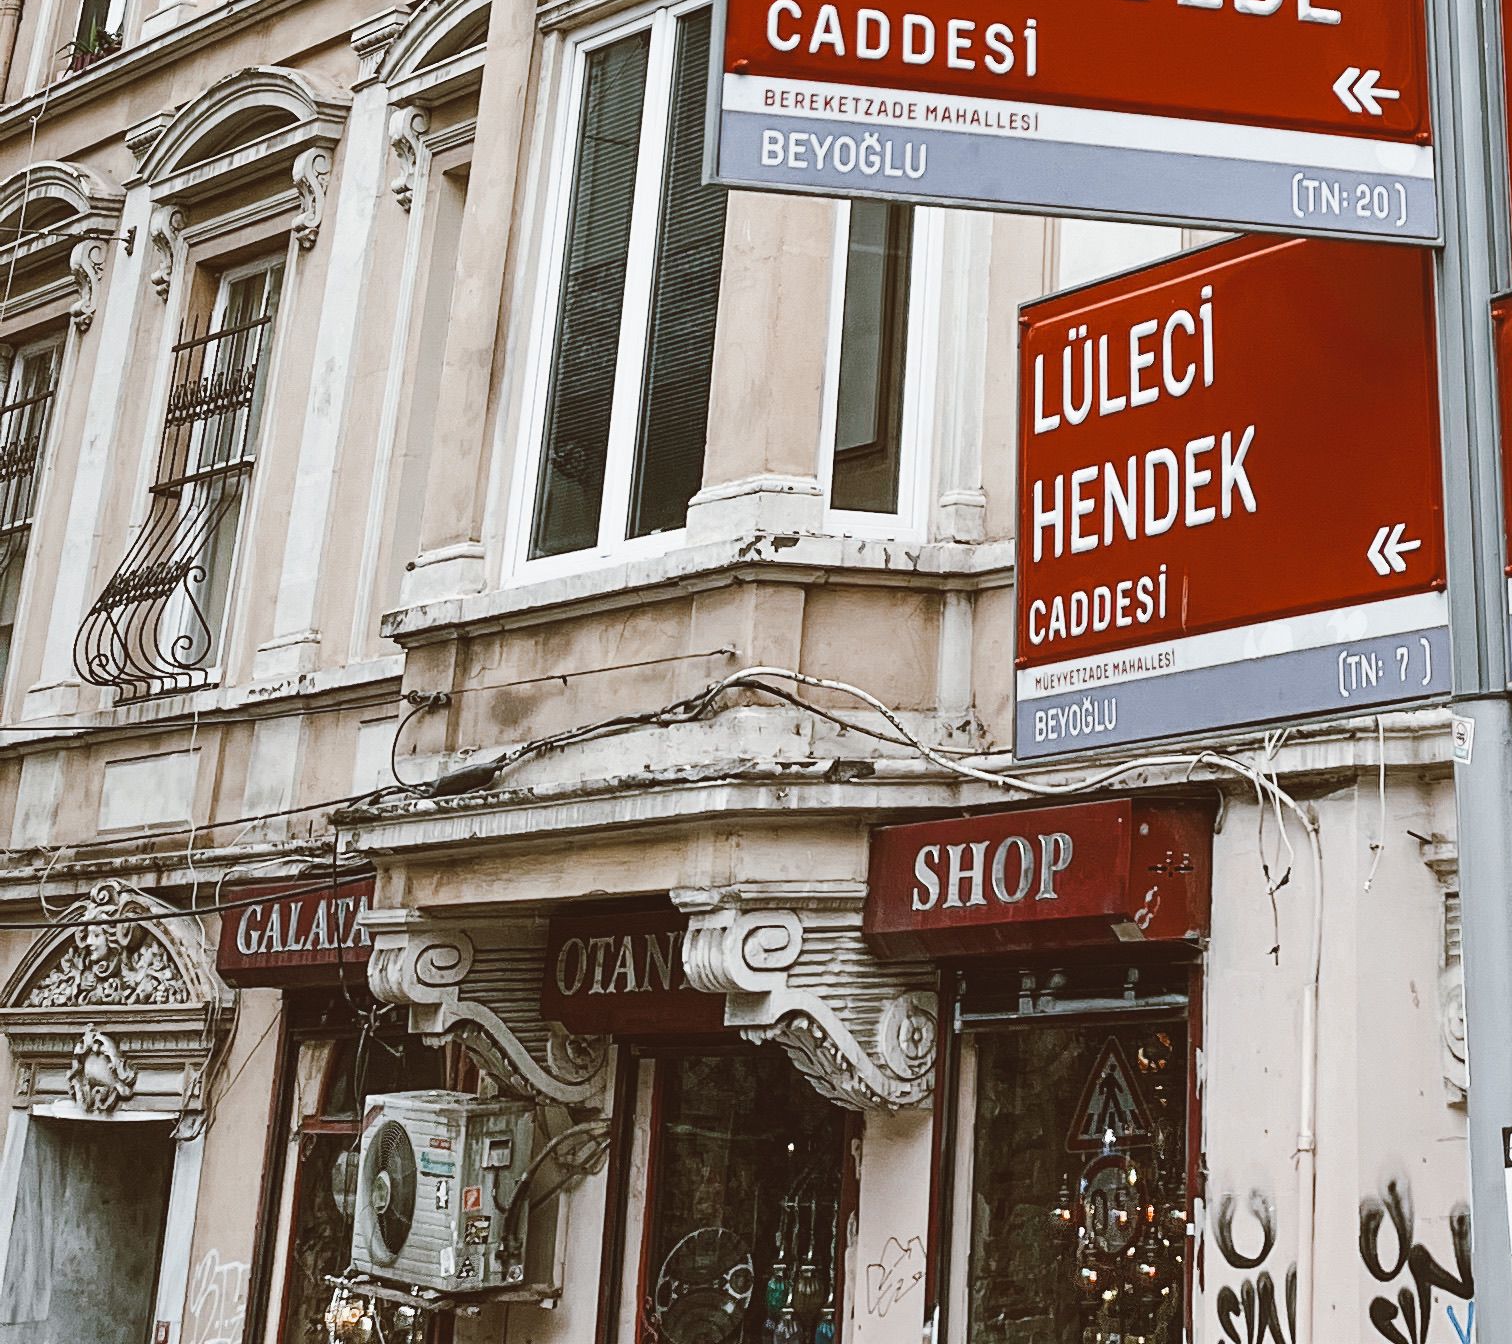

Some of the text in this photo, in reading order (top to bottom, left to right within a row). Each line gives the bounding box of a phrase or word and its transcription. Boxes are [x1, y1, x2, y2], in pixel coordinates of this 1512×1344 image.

[764, 89, 1040, 132] BEREKETZADE MAHALLESİ
[761, 129, 928, 180] BEYOĞLU
[1034, 285, 1214, 435] LÜLECİ
[1033, 425, 1257, 563] HENDEK
[1029, 564, 1167, 645] CADDESİ
[1035, 650, 1176, 691] MÜEYYETZADE MAHALLESİ
[1035, 697, 1117, 743] BEYOĞLU
[910, 831, 1074, 912] SHOP
[236, 895, 372, 955] GALATA
